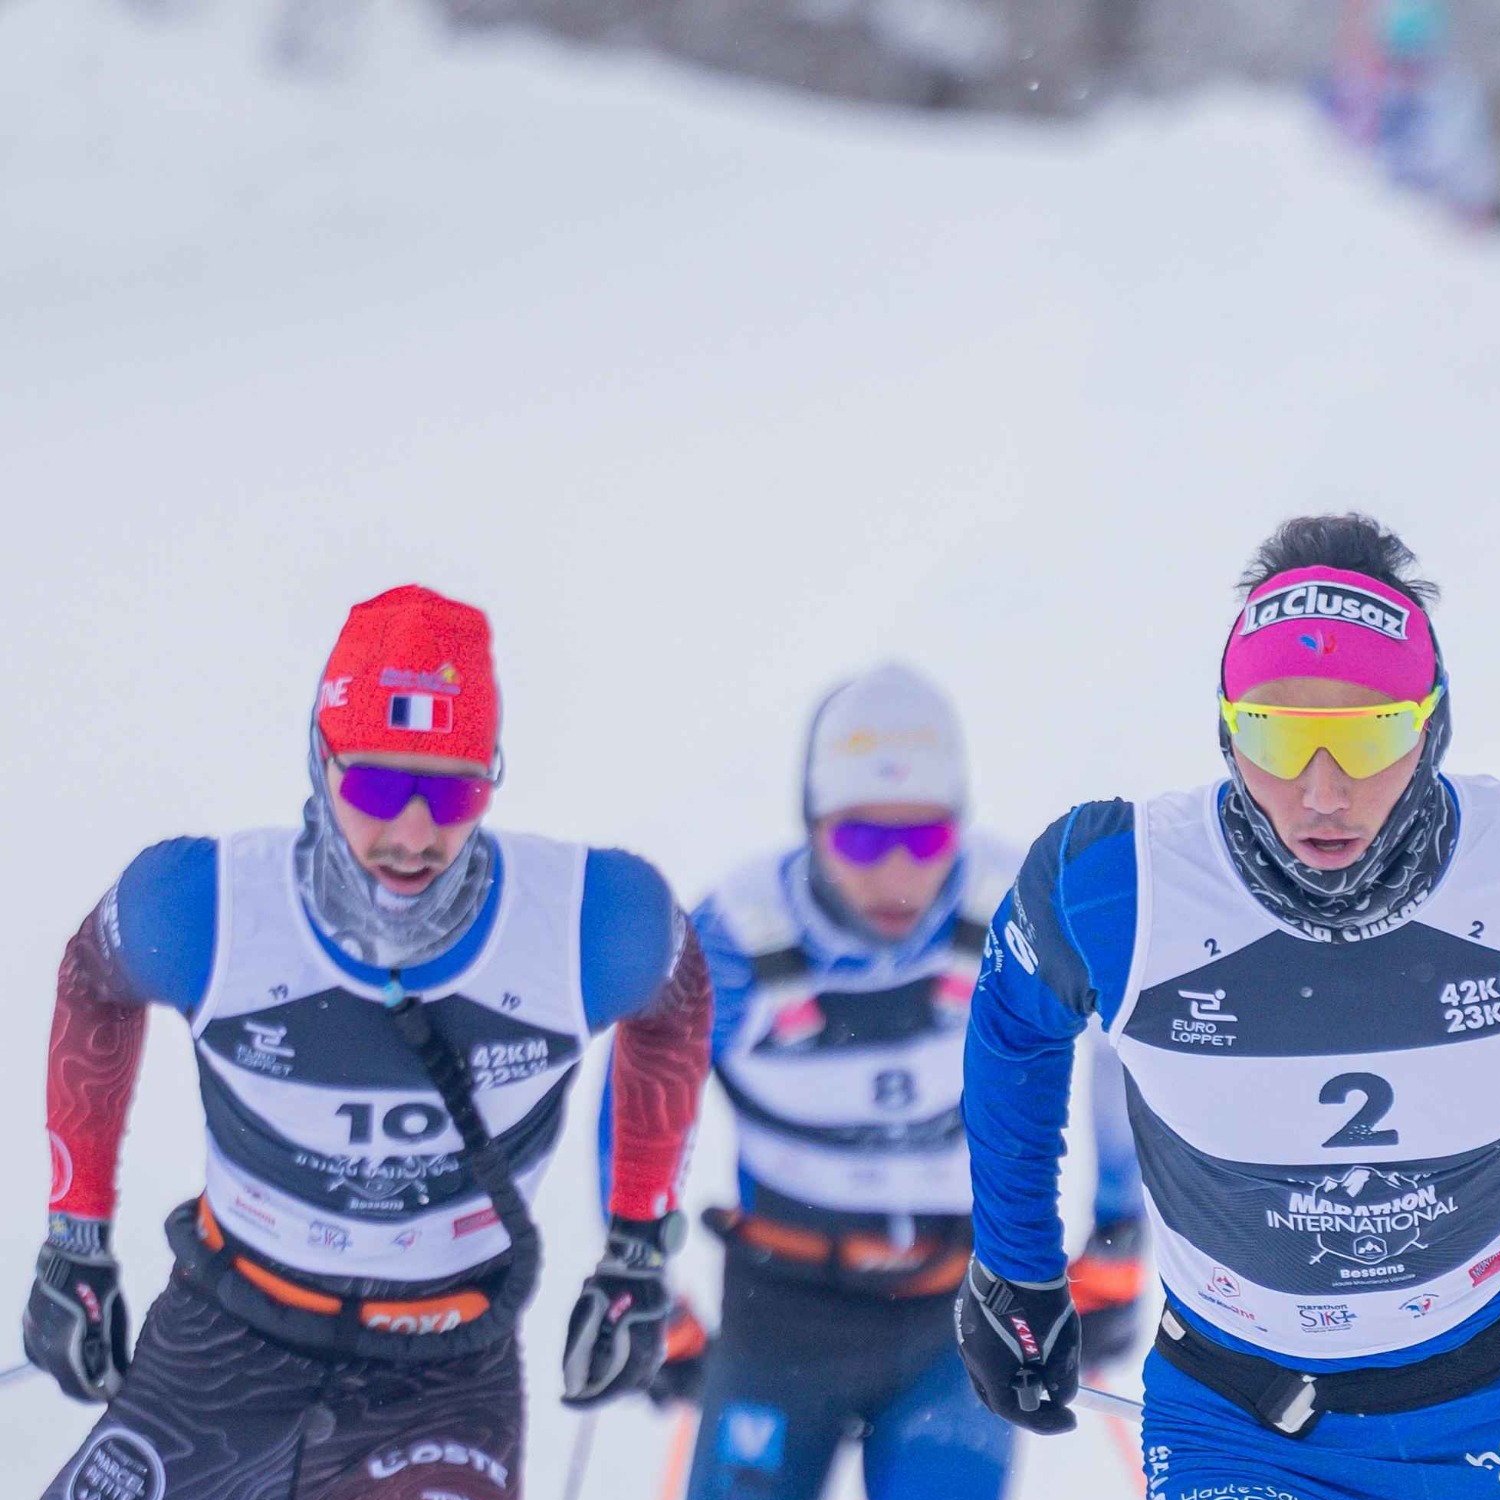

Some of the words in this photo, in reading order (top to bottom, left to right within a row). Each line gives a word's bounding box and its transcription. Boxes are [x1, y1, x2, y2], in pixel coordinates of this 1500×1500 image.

[1248, 602, 1279, 630] La
[1282, 586, 1402, 634] Clusaz
[1468, 920, 1485, 939] 2
[1203, 938, 1221, 957] 2
[1171, 1029, 1237, 1047] LOPPET
[1172, 1018, 1217, 1034] EURO
[472, 1038, 549, 1070] 42KM
[1318, 1072, 1399, 1148] 2
[335, 1102, 448, 1148] 10
[1265, 1196, 1460, 1234] INTERNATIONAL
[1339, 1263, 1406, 1280] Bessans
